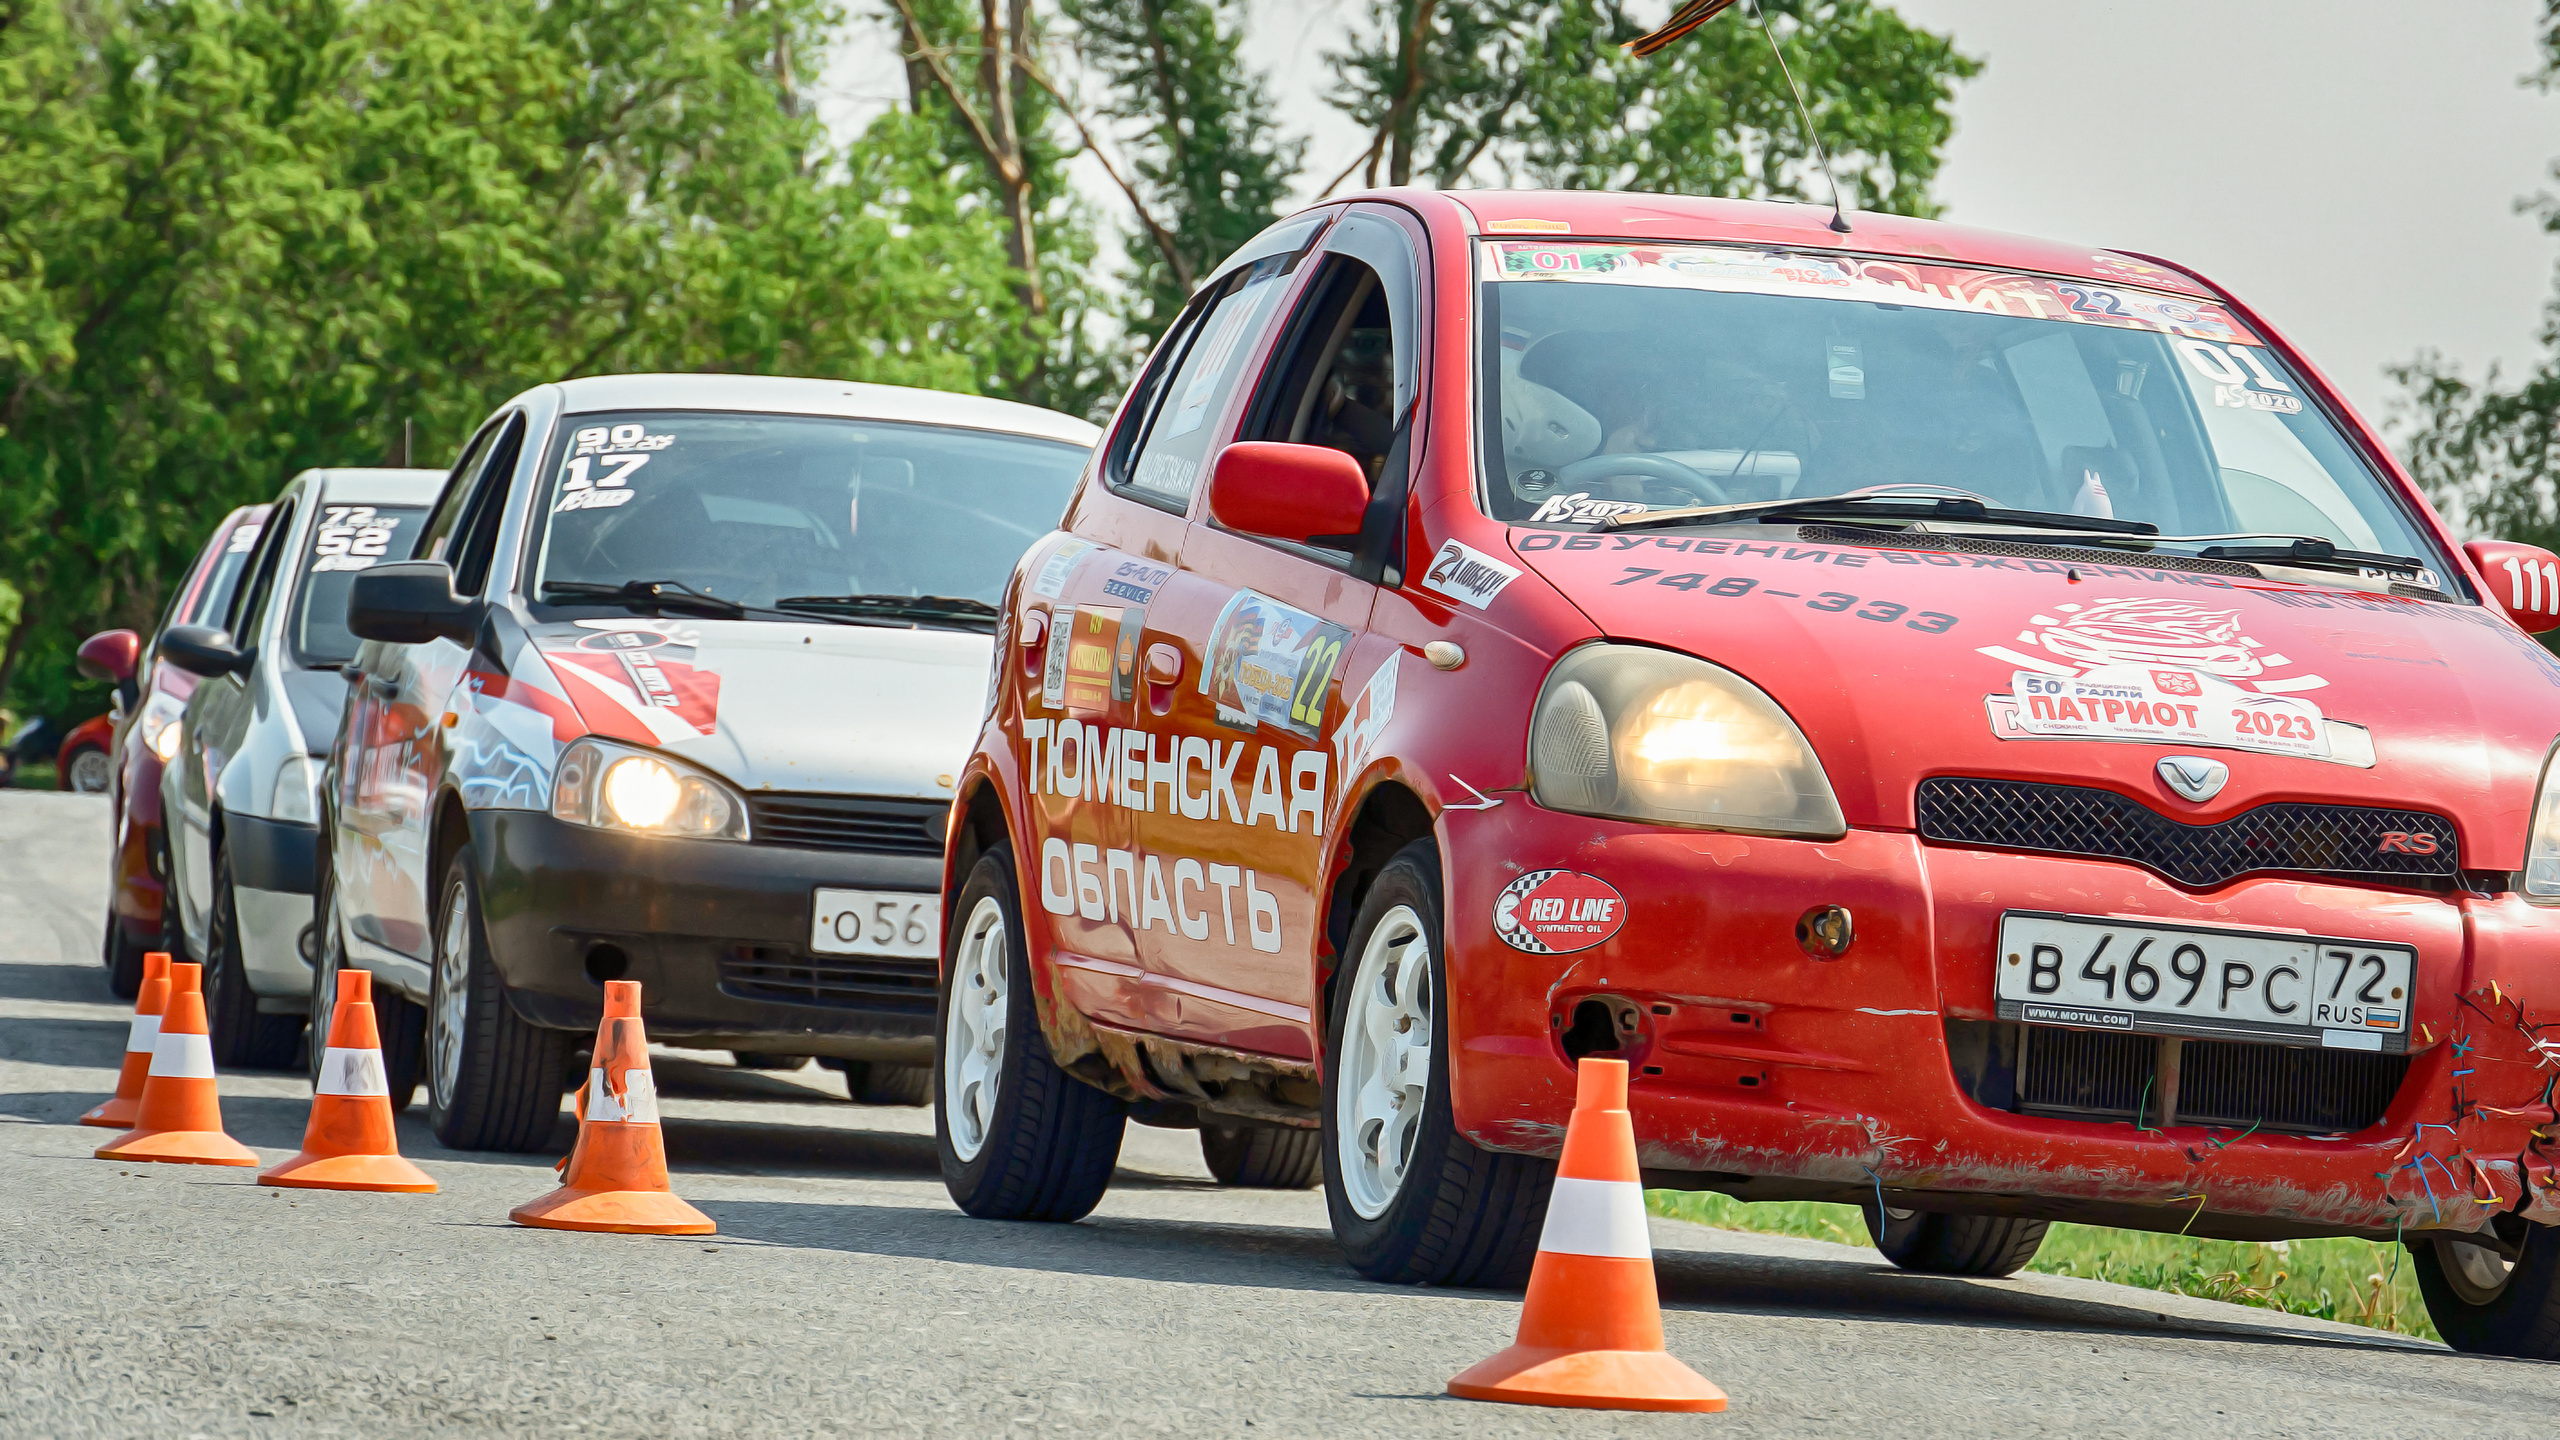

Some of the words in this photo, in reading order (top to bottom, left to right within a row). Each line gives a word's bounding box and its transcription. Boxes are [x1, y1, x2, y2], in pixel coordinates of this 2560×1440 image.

[1533, 251, 1581, 270] 01
[2059, 287, 2133, 316] 22
[2176, 340, 2292, 393] 01
[576, 424, 645, 447] 90
[562, 453, 650, 491] 17
[325, 506, 378, 525] 72
[315, 527, 392, 557] 52
[1518, 534, 1870, 569] ОБУЧЕНИЕ
[1877, 551, 2235, 590] ВОЖДЕНИЮ
[1610, 566, 1960, 634] 748-333
[2502, 557, 2560, 616] 111
[1290, 635, 1342, 727] 22
[2026, 678, 2062, 694] 50
[2075, 688, 2143, 699] РАЛЛИ
[2028, 695, 2199, 729] ПАТРИОТ
[2231, 708, 2316, 741] 2023
[1023, 717, 1328, 836] ТЮМЕНСКАЯ
[2377, 831, 2438, 855] RS
[1042, 836, 1282, 954] ОБЛАСТЬ
[1528, 898, 1566, 922] RED
[1569, 898, 1616, 922] LINE
[1536, 924, 1584, 934] SYNTHETIC
[1586, 925, 1603, 934] OIL
[2326, 951, 2386, 1004] 72
[2027, 1007, 2130, 1027] WWW.MOTUL.COM
[2317, 1003, 2363, 1026] RUS
